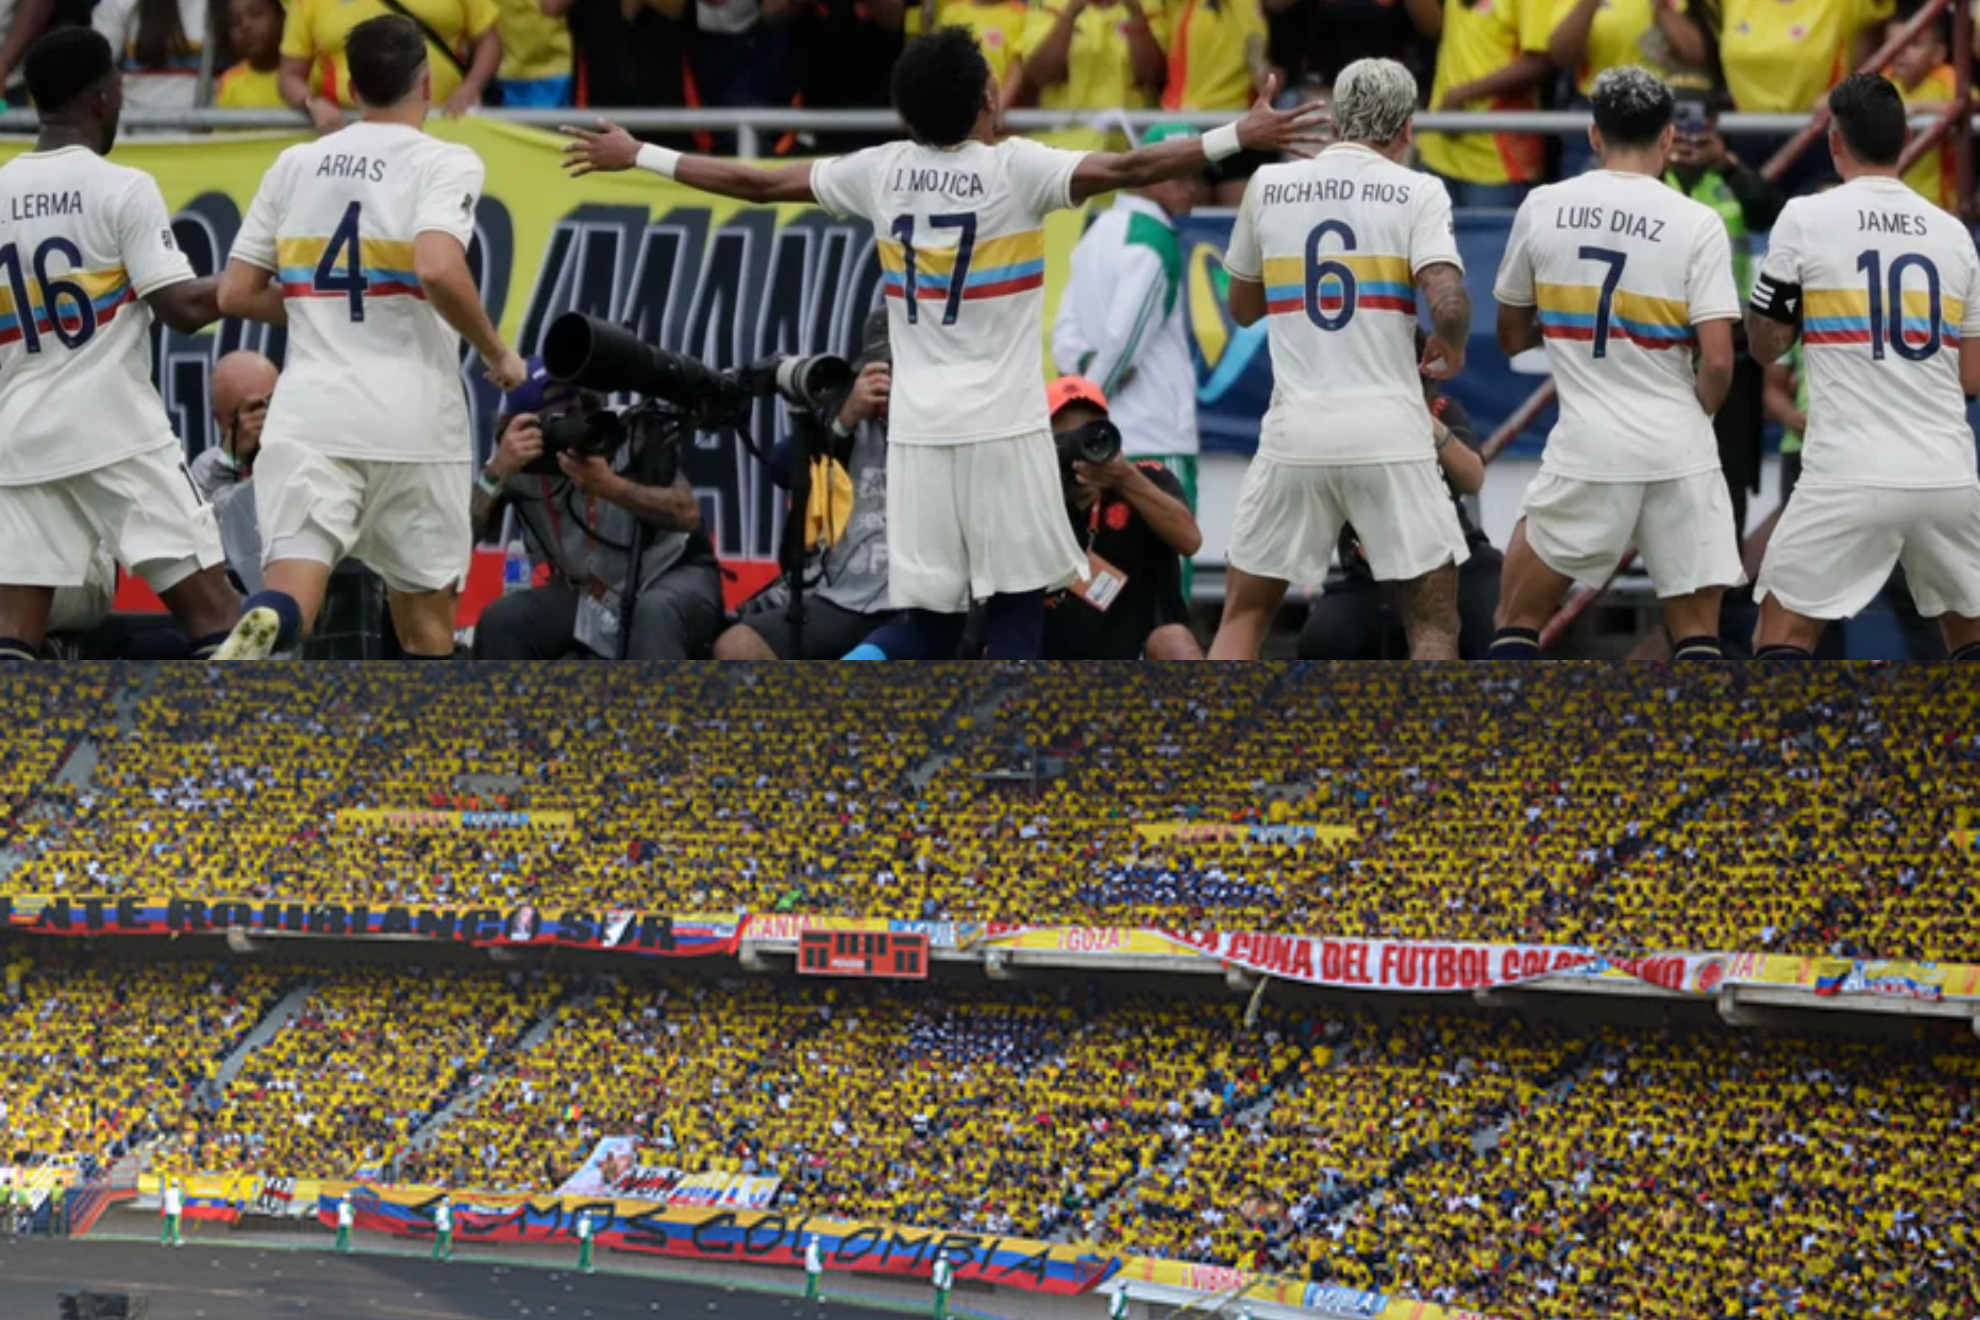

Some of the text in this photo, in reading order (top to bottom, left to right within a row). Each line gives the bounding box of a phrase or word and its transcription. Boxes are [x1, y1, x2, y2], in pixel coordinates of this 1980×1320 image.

[316, 153, 387, 183] ARIAS
[892, 168, 984, 198] J. MOJICA
[1263, 177, 1411, 206] RICHARD RIOS
[12, 190, 83, 221] LERMA
[1556, 206, 1666, 243] LUIS DIAZ
[1857, 209, 1929, 237] JAMES
[313, 200, 369, 324] 4
[890, 210, 978, 326] 17
[1303, 219, 1358, 332] 6
[0, 236, 97, 355] 16
[1577, 245, 1628, 360] 7
[1856, 249, 1943, 362] 10
[1225, 931, 1313, 978] CUNA
[1321, 941, 1373, 984] DEL
[1380, 943, 1495, 988] FUTBOL
[692, 1211, 1054, 1286] COLOMBIA
